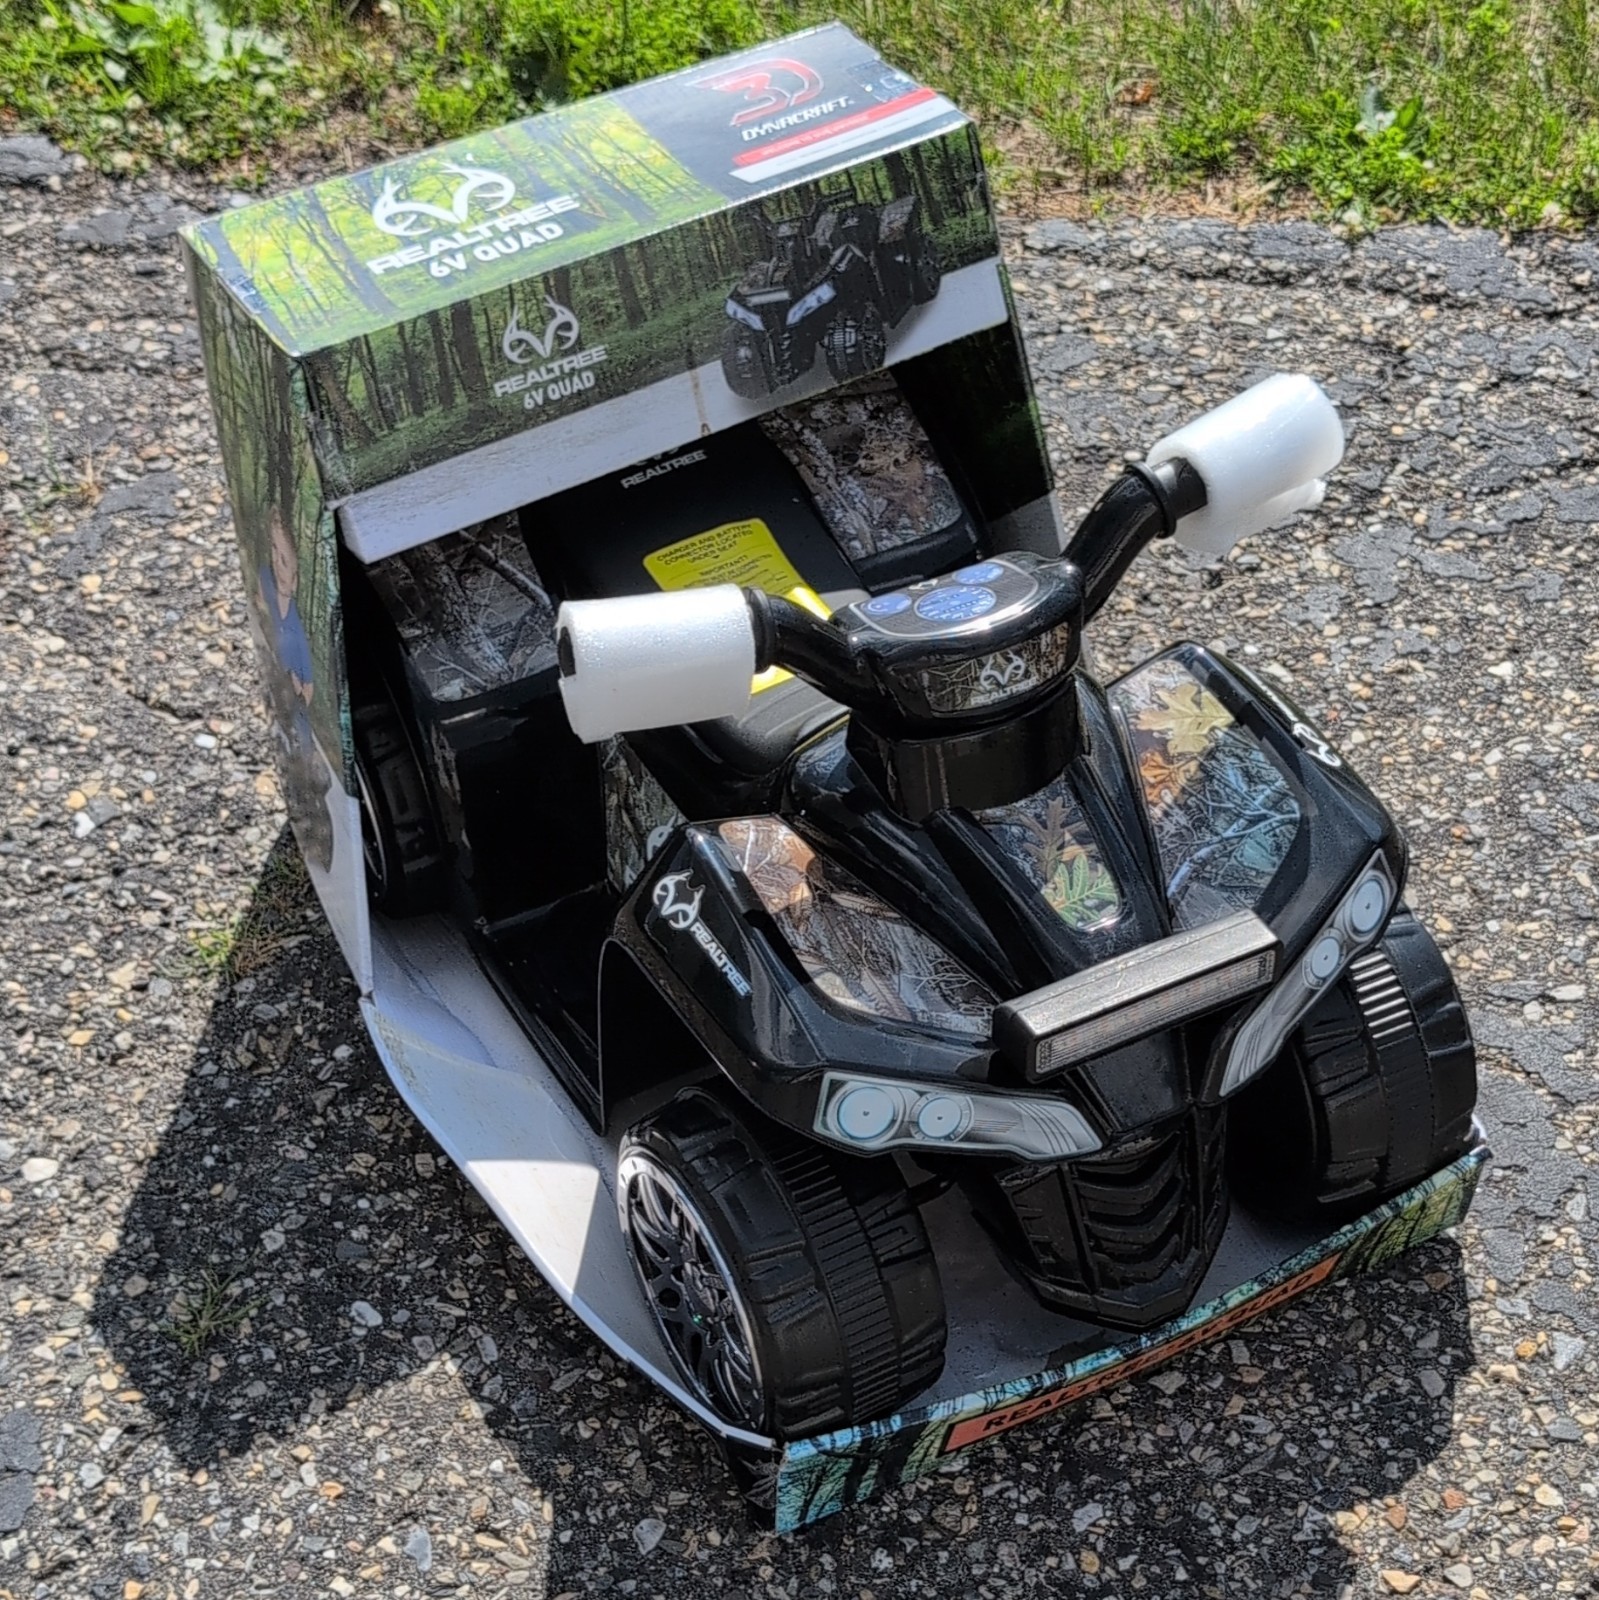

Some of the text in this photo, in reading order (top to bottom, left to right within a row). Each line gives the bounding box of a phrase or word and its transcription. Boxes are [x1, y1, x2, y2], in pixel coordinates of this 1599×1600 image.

[741, 95, 849, 142] DYNACRAFT
[366, 194, 580, 275] REALTREE
[429, 222, 564, 278] 6V QUAD
[493, 345, 608, 398] REALTREE
[523, 370, 596, 410] 6V QUAD
[619, 449, 708, 489] REALTREE
[970, 676, 1038, 706] REALTREE
[689, 920, 753, 997] REALTREE
[1225, 1272, 1314, 1323] QUAD
